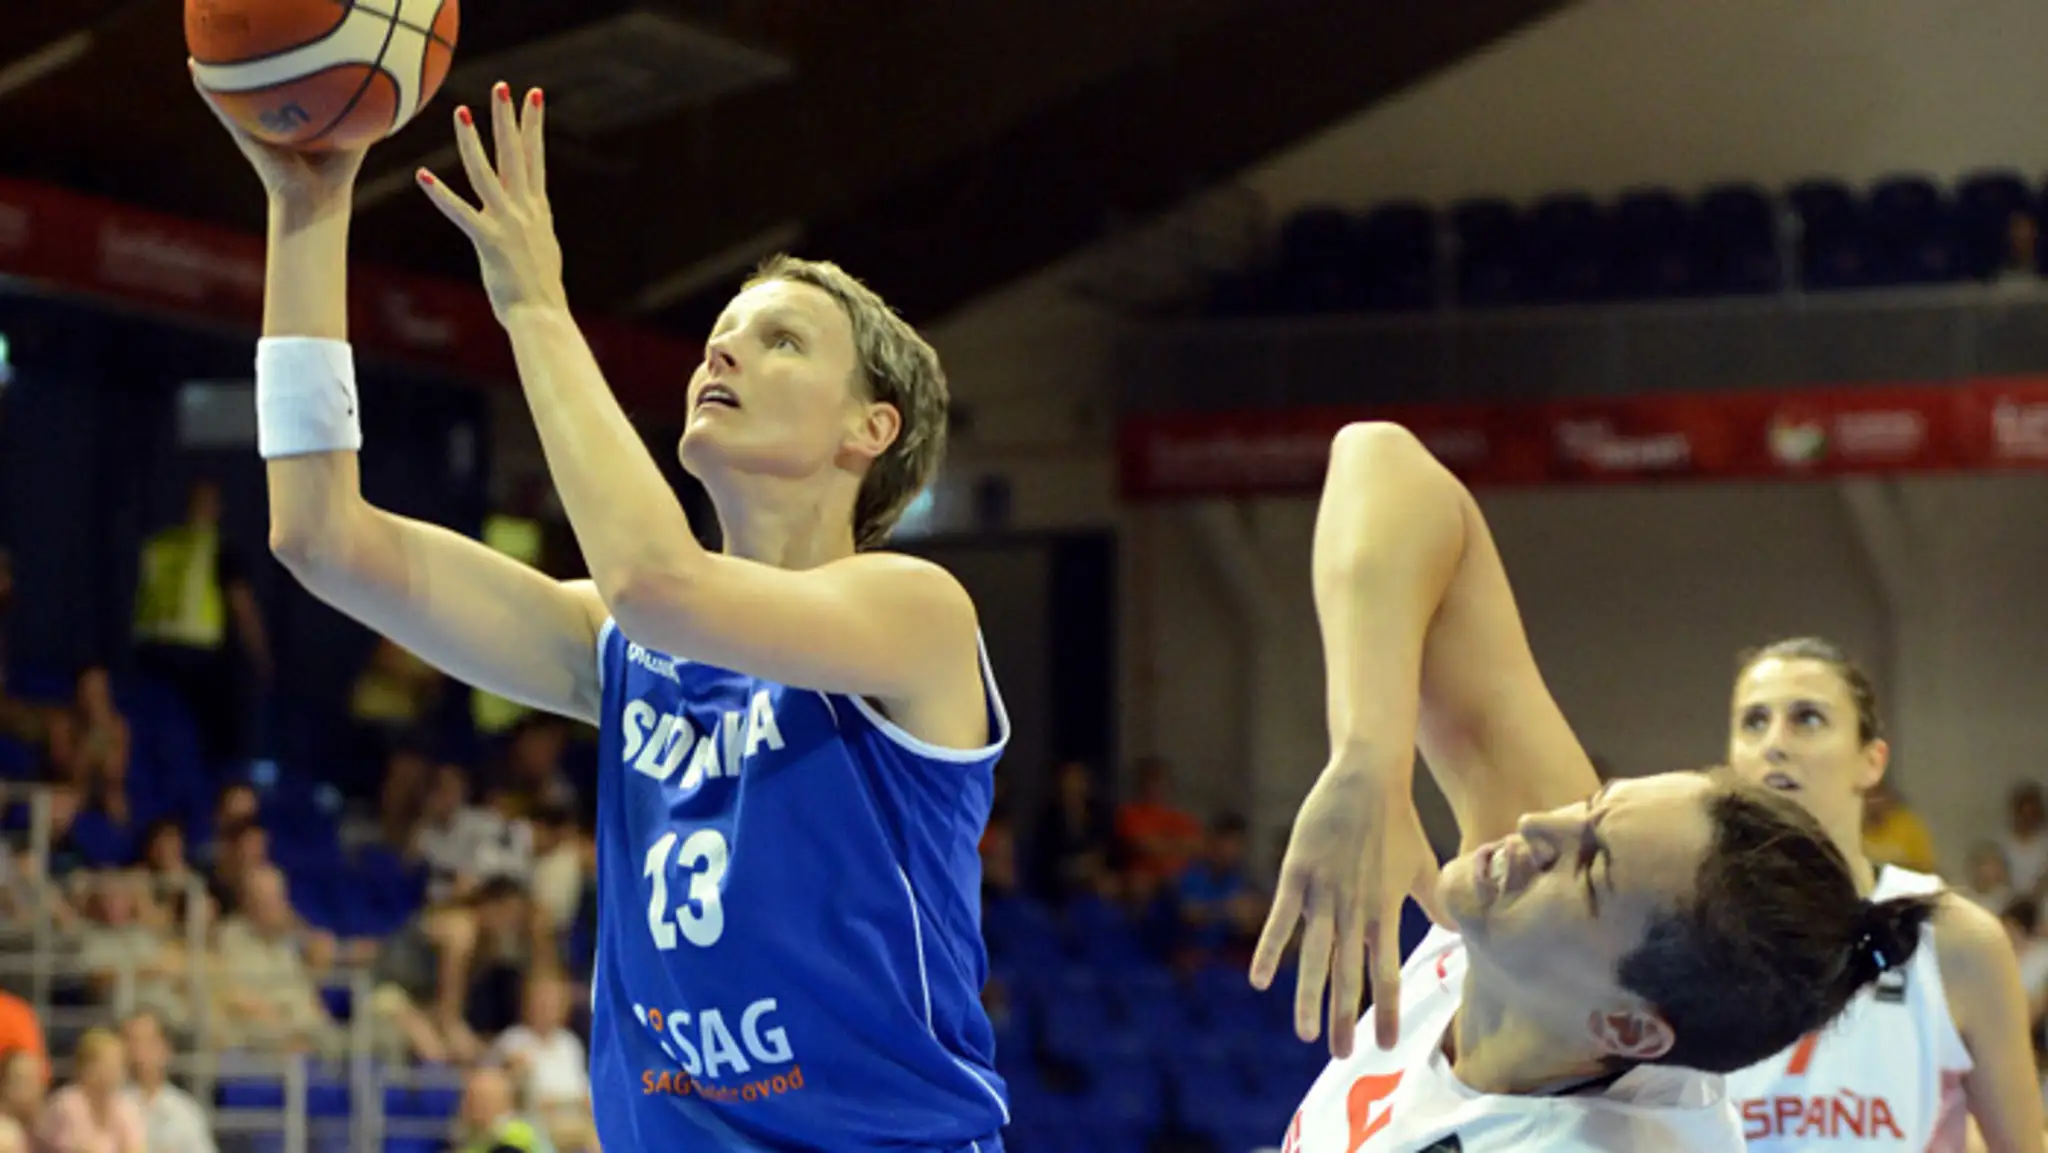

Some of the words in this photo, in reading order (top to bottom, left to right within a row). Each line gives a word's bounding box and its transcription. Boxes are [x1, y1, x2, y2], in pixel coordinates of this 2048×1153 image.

[643, 828, 729, 952] 13
[667, 997, 794, 1079] SAG
[1740, 1087, 1906, 1140] SPAÑA
